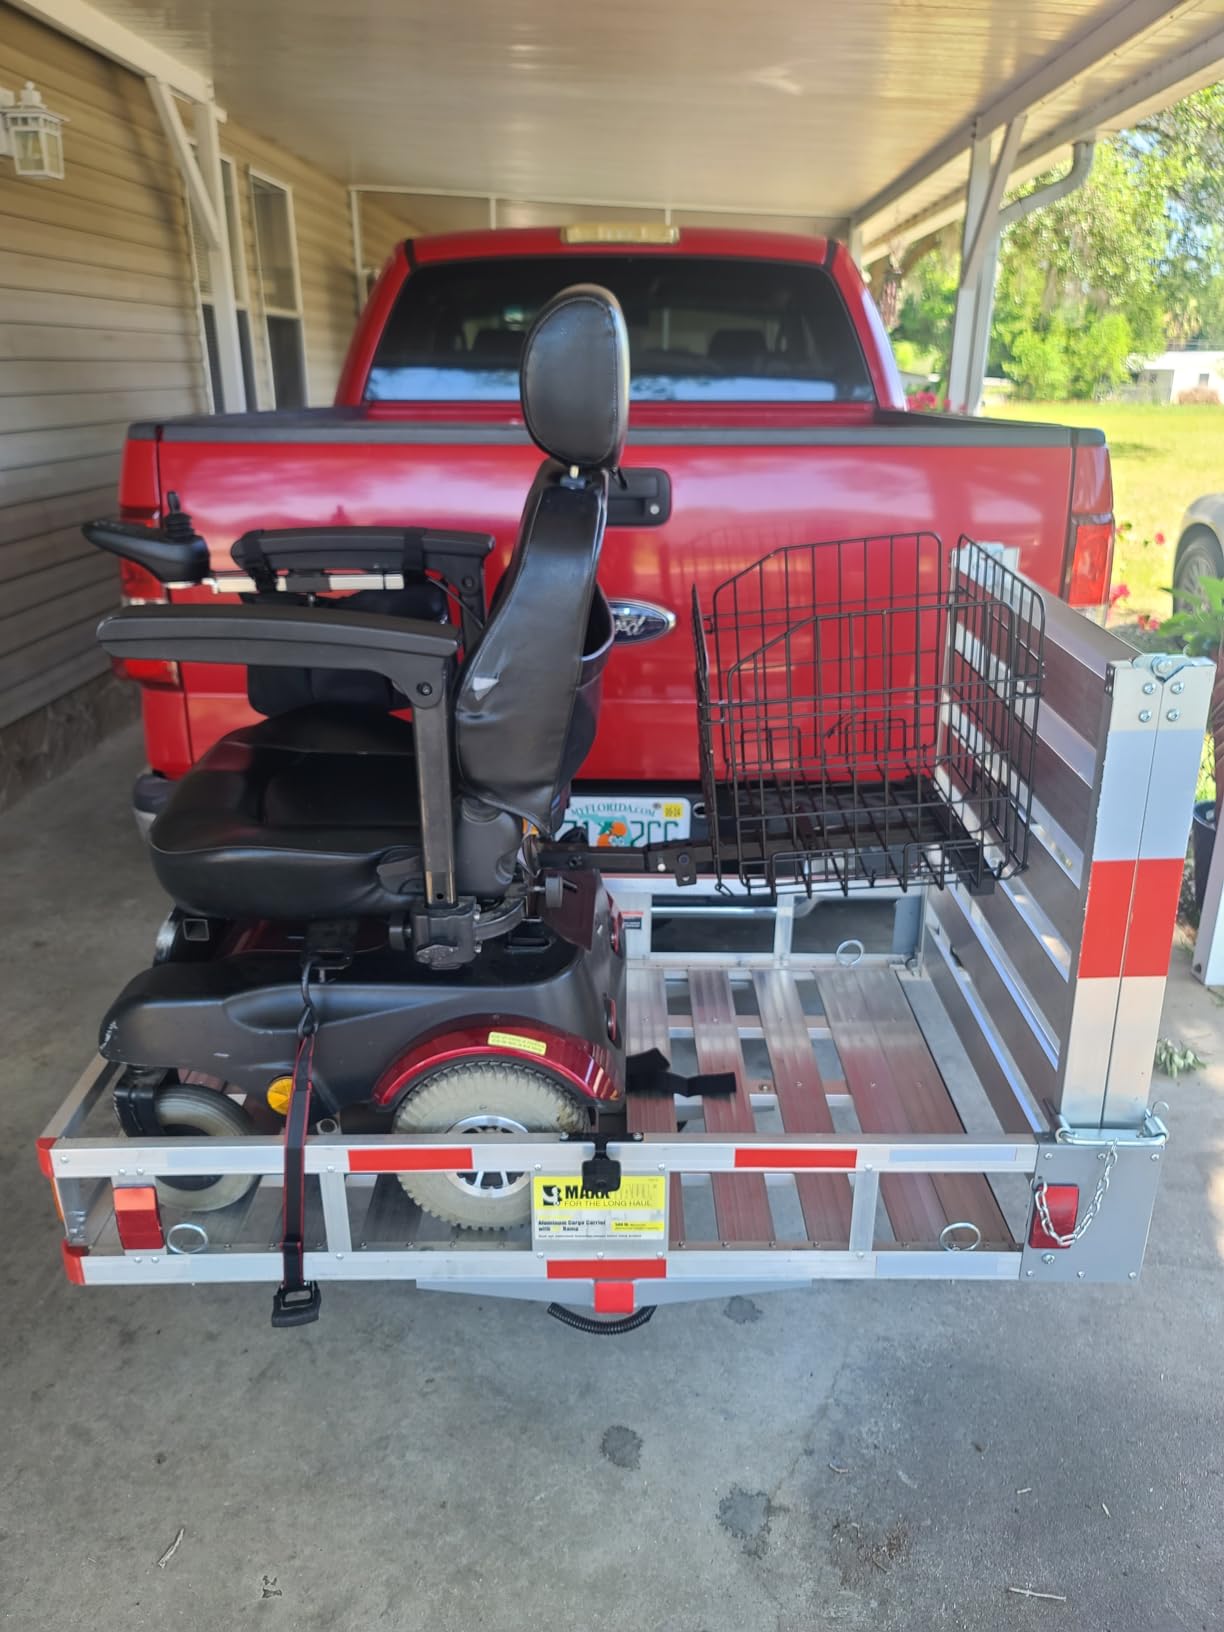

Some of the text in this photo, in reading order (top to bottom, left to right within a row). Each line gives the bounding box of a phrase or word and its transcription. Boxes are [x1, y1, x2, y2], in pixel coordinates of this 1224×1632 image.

[570, 802, 656, 817] MYFLORIDA.COM
[564, 1200, 582, 1208] FOR
[586, 1200, 601, 1208] THE
[603, 1200, 627, 1208] LONG
